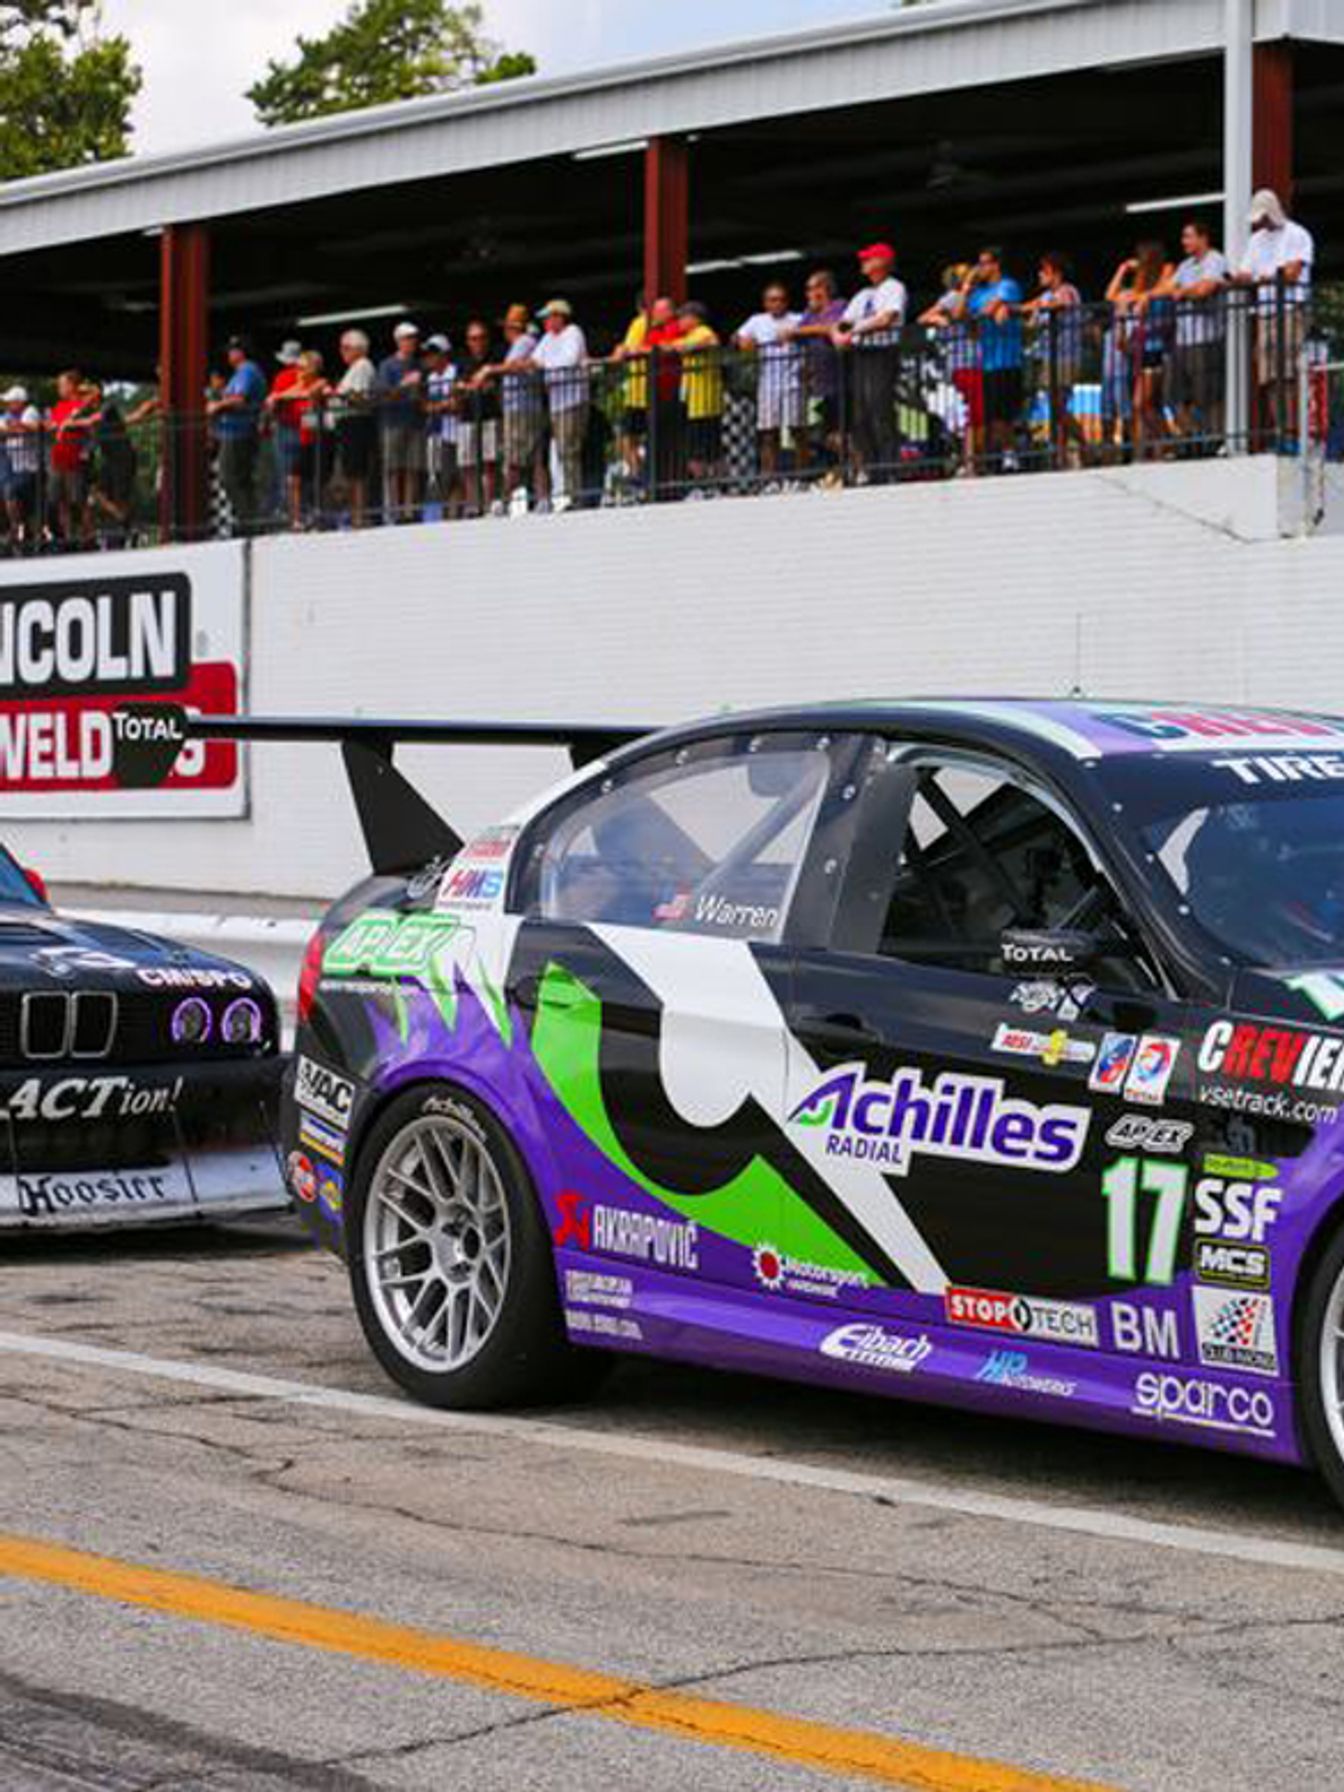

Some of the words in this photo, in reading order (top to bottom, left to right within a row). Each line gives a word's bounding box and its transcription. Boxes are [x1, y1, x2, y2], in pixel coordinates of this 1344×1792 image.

[0, 591, 176, 684] COLN
[695, 895, 778, 927] Warren
[787, 1072, 1078, 1163] Achilles
[1201, 1084, 1338, 1125] vsetrack.com
[826, 1134, 903, 1164] RADIAL
[1111, 1117, 1191, 1148] APEX
[1101, 1156, 1189, 1286] 17
[1195, 1178, 1283, 1242] SSF
[1201, 1245, 1265, 1276] MCS
[1111, 1301, 1180, 1359] BM
[1135, 1372, 1275, 1426] sparco
